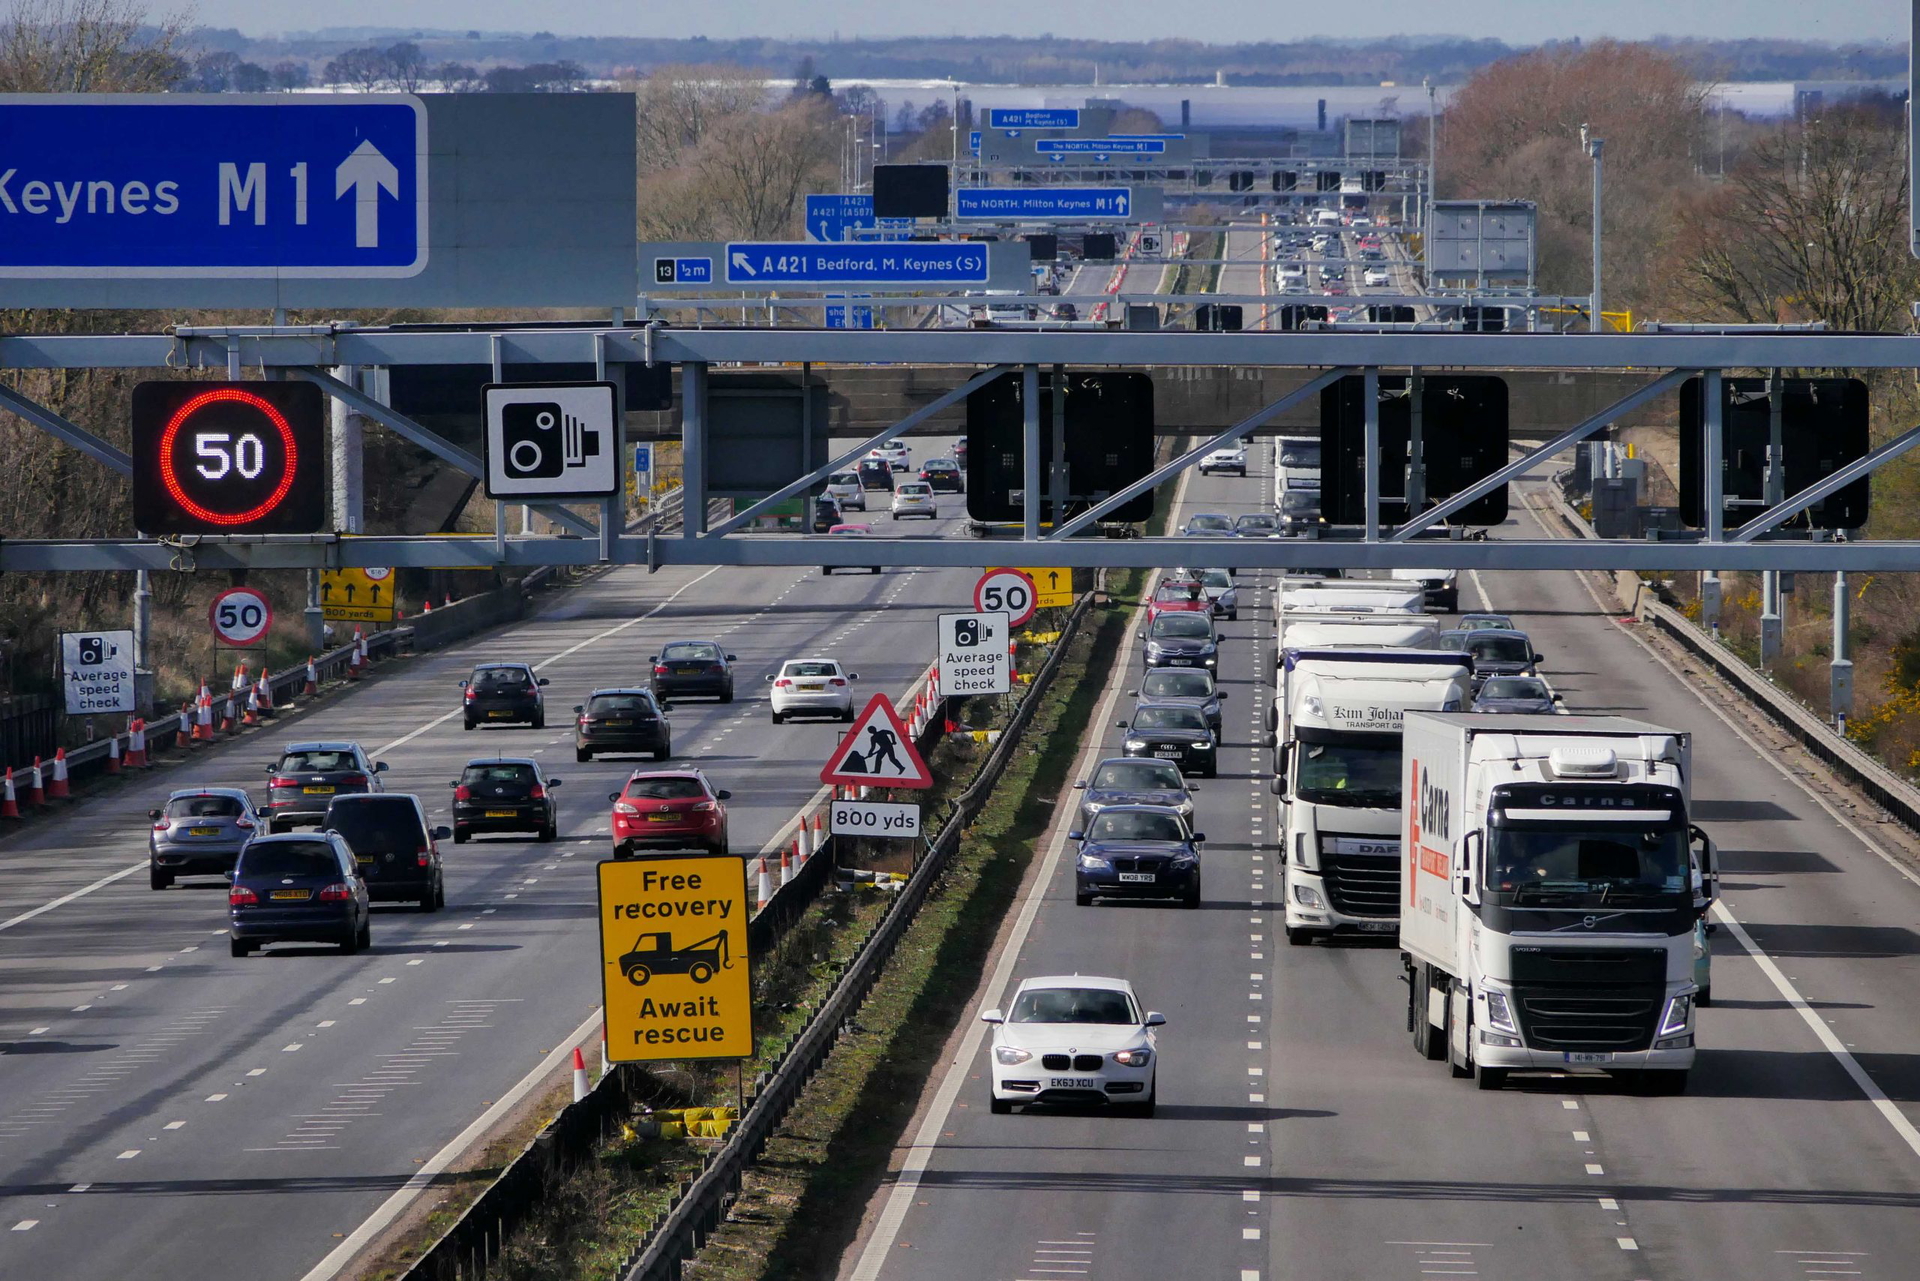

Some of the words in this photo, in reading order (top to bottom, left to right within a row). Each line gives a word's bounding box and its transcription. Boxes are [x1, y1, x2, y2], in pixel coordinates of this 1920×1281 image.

[1113, 143, 1134, 151] Keynes
[961, 199, 978, 208] The
[1023, 199, 1054, 208] Milton
[1057, 199, 1091, 210] Keynes
[659, 266, 672, 277] 13
[195, 432, 264, 480] 50
[984, 586, 1027, 611] 50
[218, 604, 263, 629] 50
[324, 608, 347, 617] 600
[348, 610, 374, 619] yards
[945, 651, 1003, 665] Average
[71, 669, 128, 684] Average
[953, 664, 995, 678] speed
[79, 683, 120, 698] speed
[954, 678, 996, 691] check
[79, 696, 120, 709] check
[1332, 705, 1363, 719] Kim
[1346, 721, 1390, 729] TRANSPORT
[1421, 765, 1450, 842] Carna
[1540, 794, 1635, 806] Carna
[835, 810, 877, 827] 800
[883, 810, 916, 830] yds
[1359, 844, 1400, 854] DAF
[642, 870, 703, 893] Free
[613, 897, 733, 920] recovery
[639, 996, 720, 1020] Await
[632, 1025, 725, 1045] rescue
[1050, 1078, 1075, 1087] EK63
[1076, 1079, 1094, 1087] XCU
